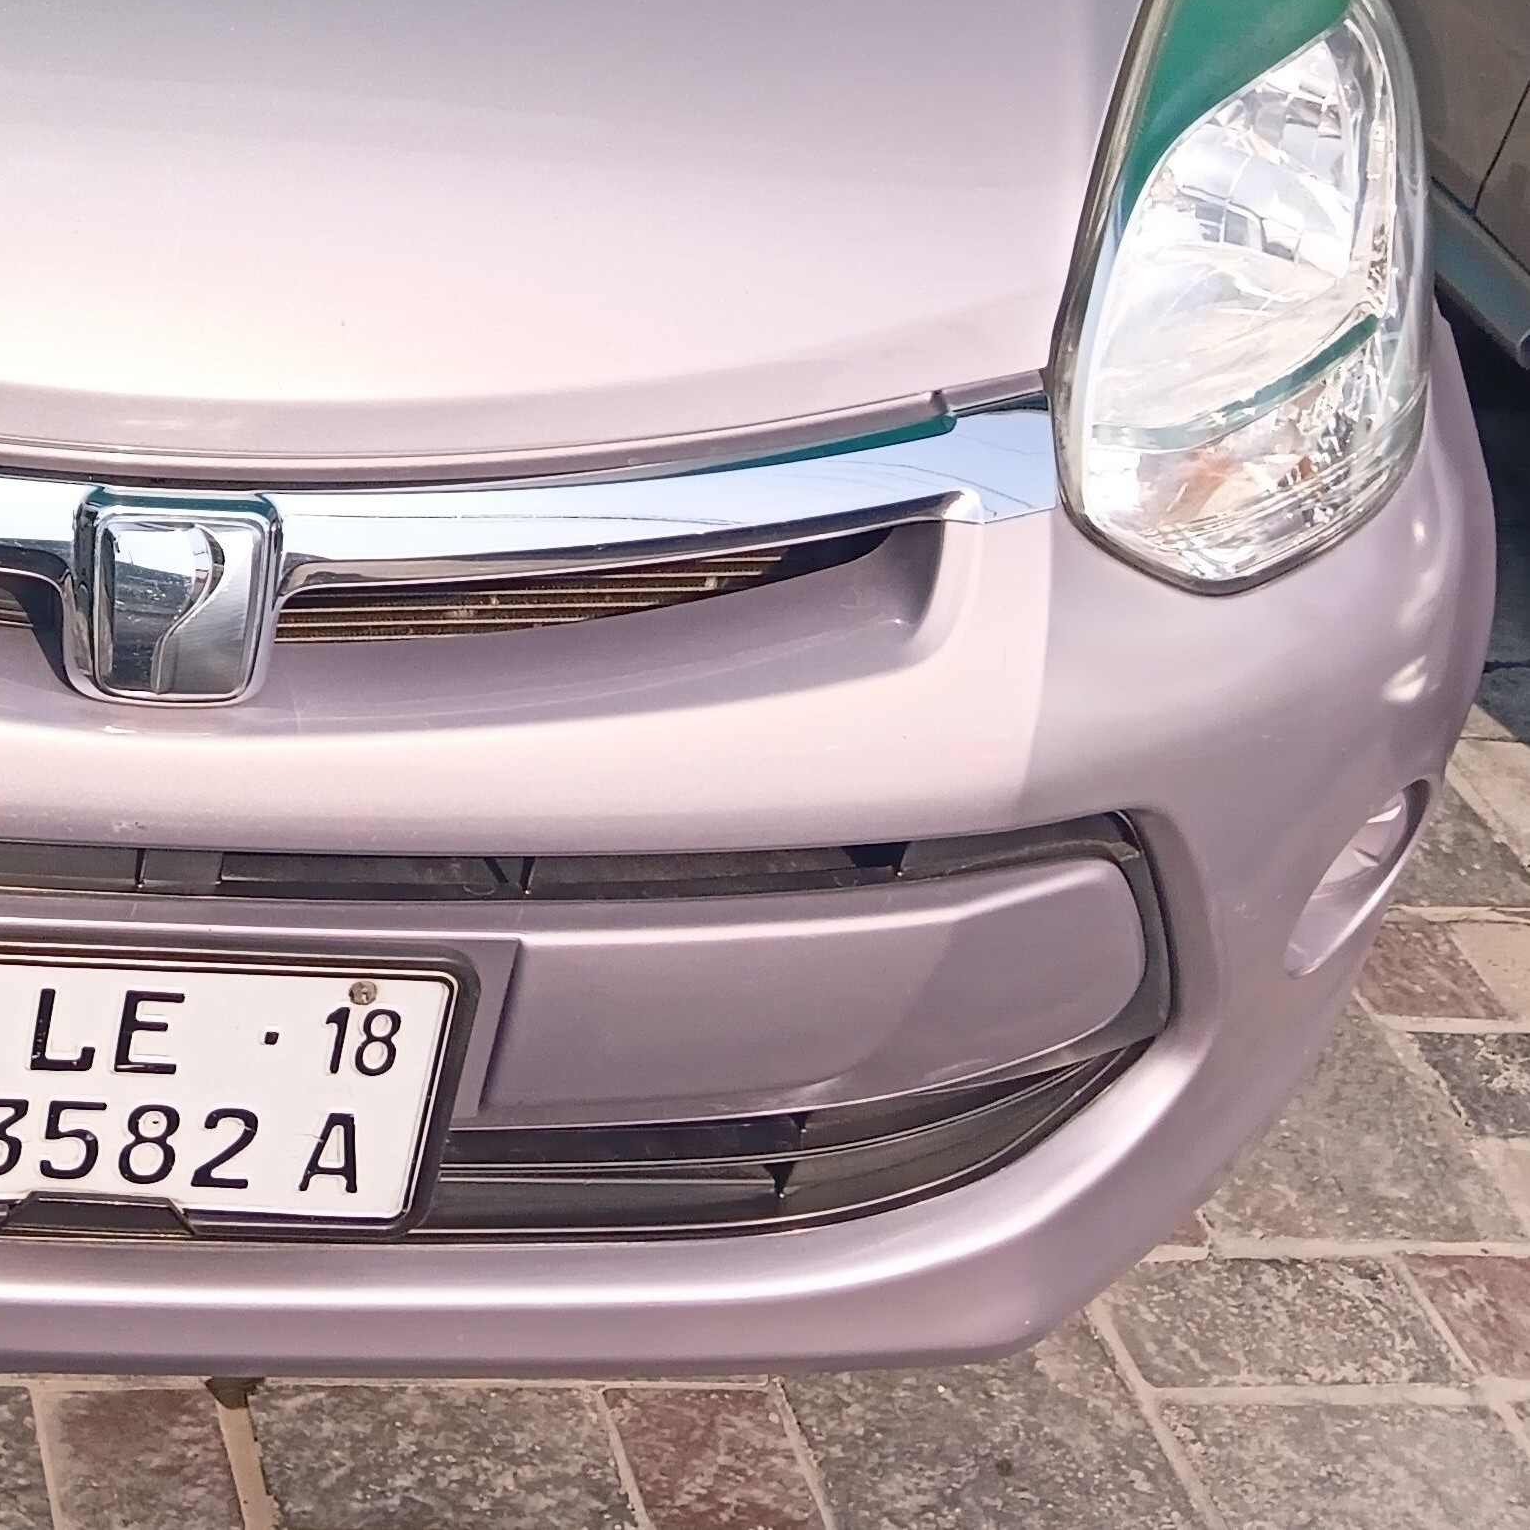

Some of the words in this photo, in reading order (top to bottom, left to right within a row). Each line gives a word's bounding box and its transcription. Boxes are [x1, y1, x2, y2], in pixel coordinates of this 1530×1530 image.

[28, 987, 187, 1075] LE
[325, 1006, 403, 1077] 18
[297, 1111, 359, 1194] A
